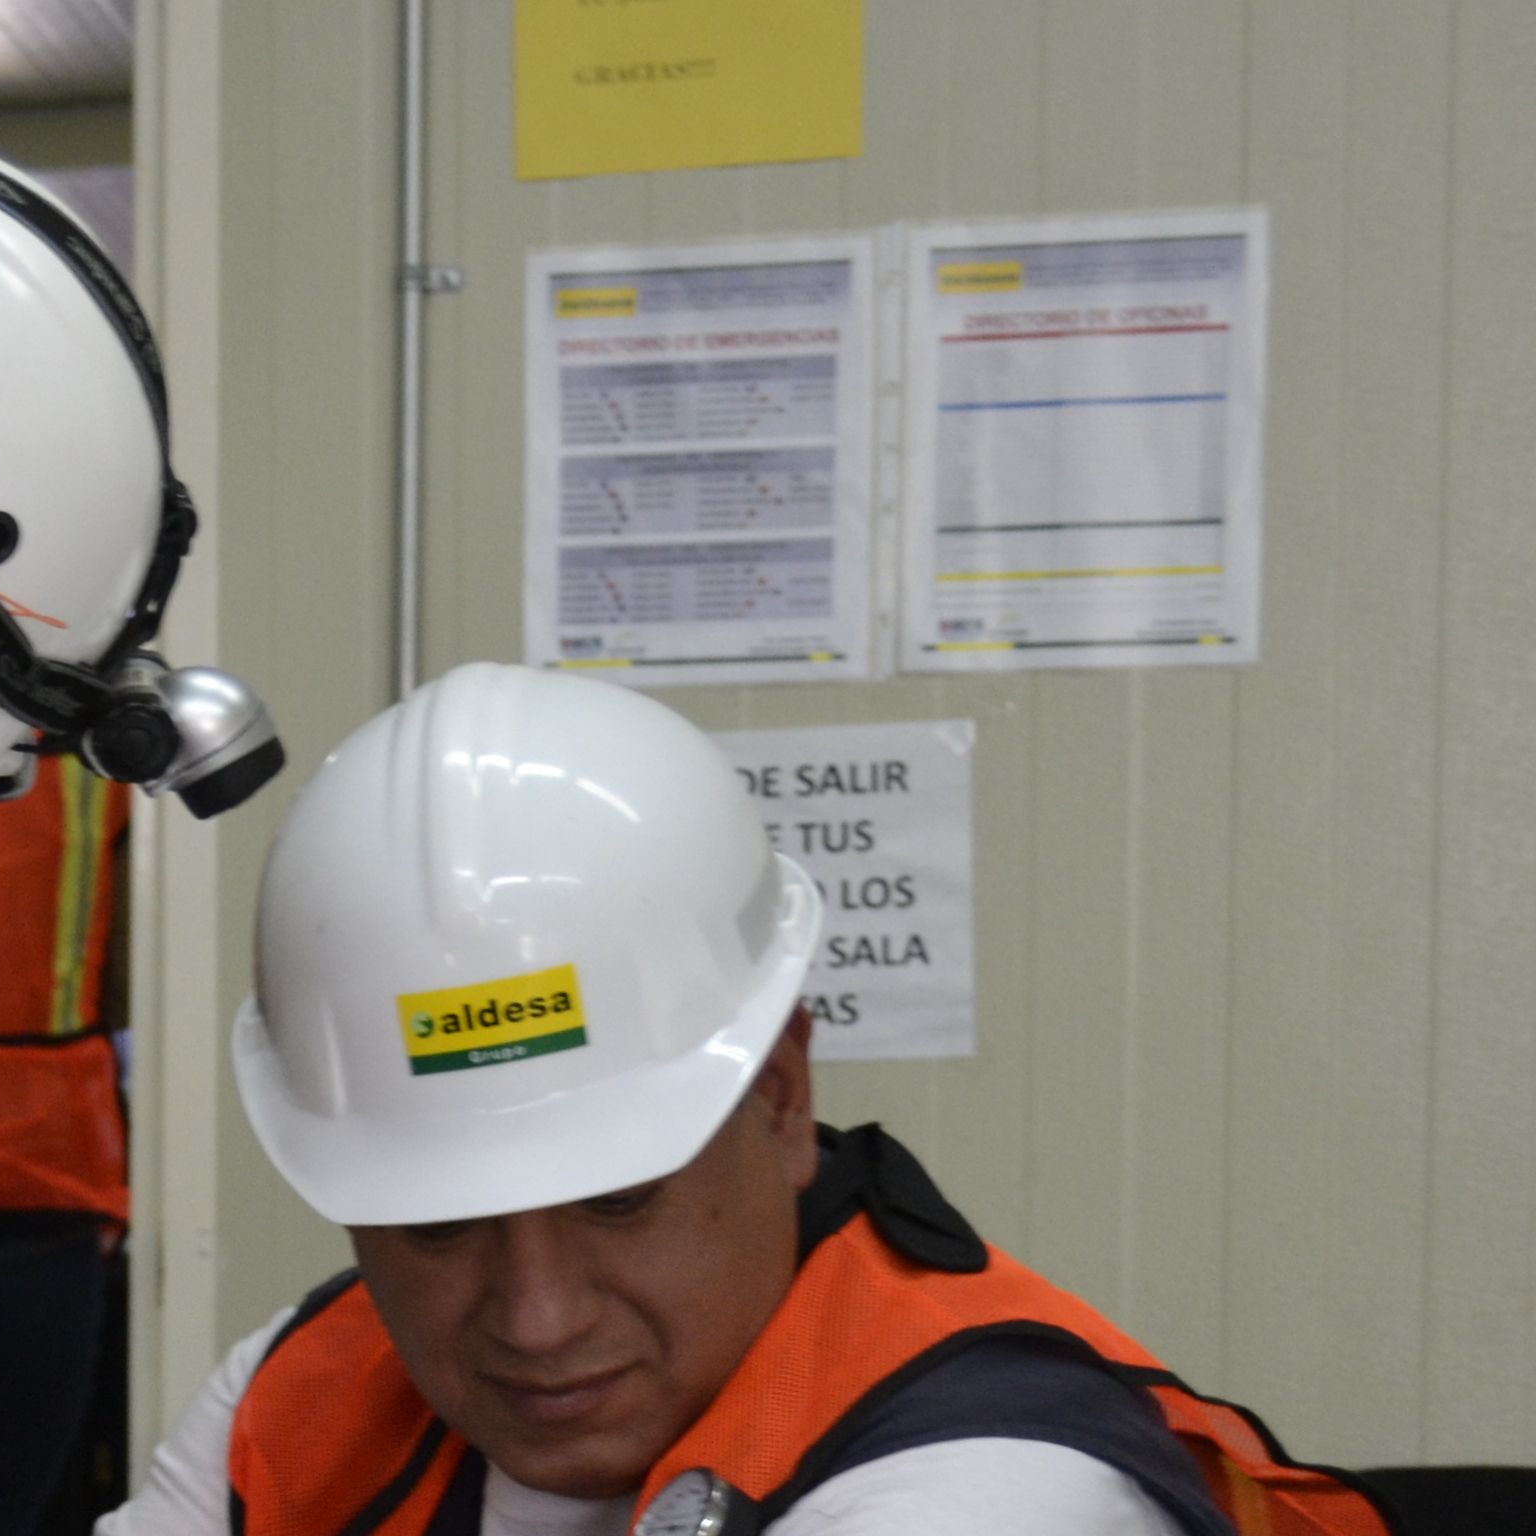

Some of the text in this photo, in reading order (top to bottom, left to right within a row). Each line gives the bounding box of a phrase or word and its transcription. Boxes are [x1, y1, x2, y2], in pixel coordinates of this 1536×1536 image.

[794, 759, 910, 798] SALIR
[795, 819, 875, 855] TUS
[839, 875, 916, 911] LOS
[828, 933, 931, 968] SALA
[440, 990, 574, 1035] aldesa
